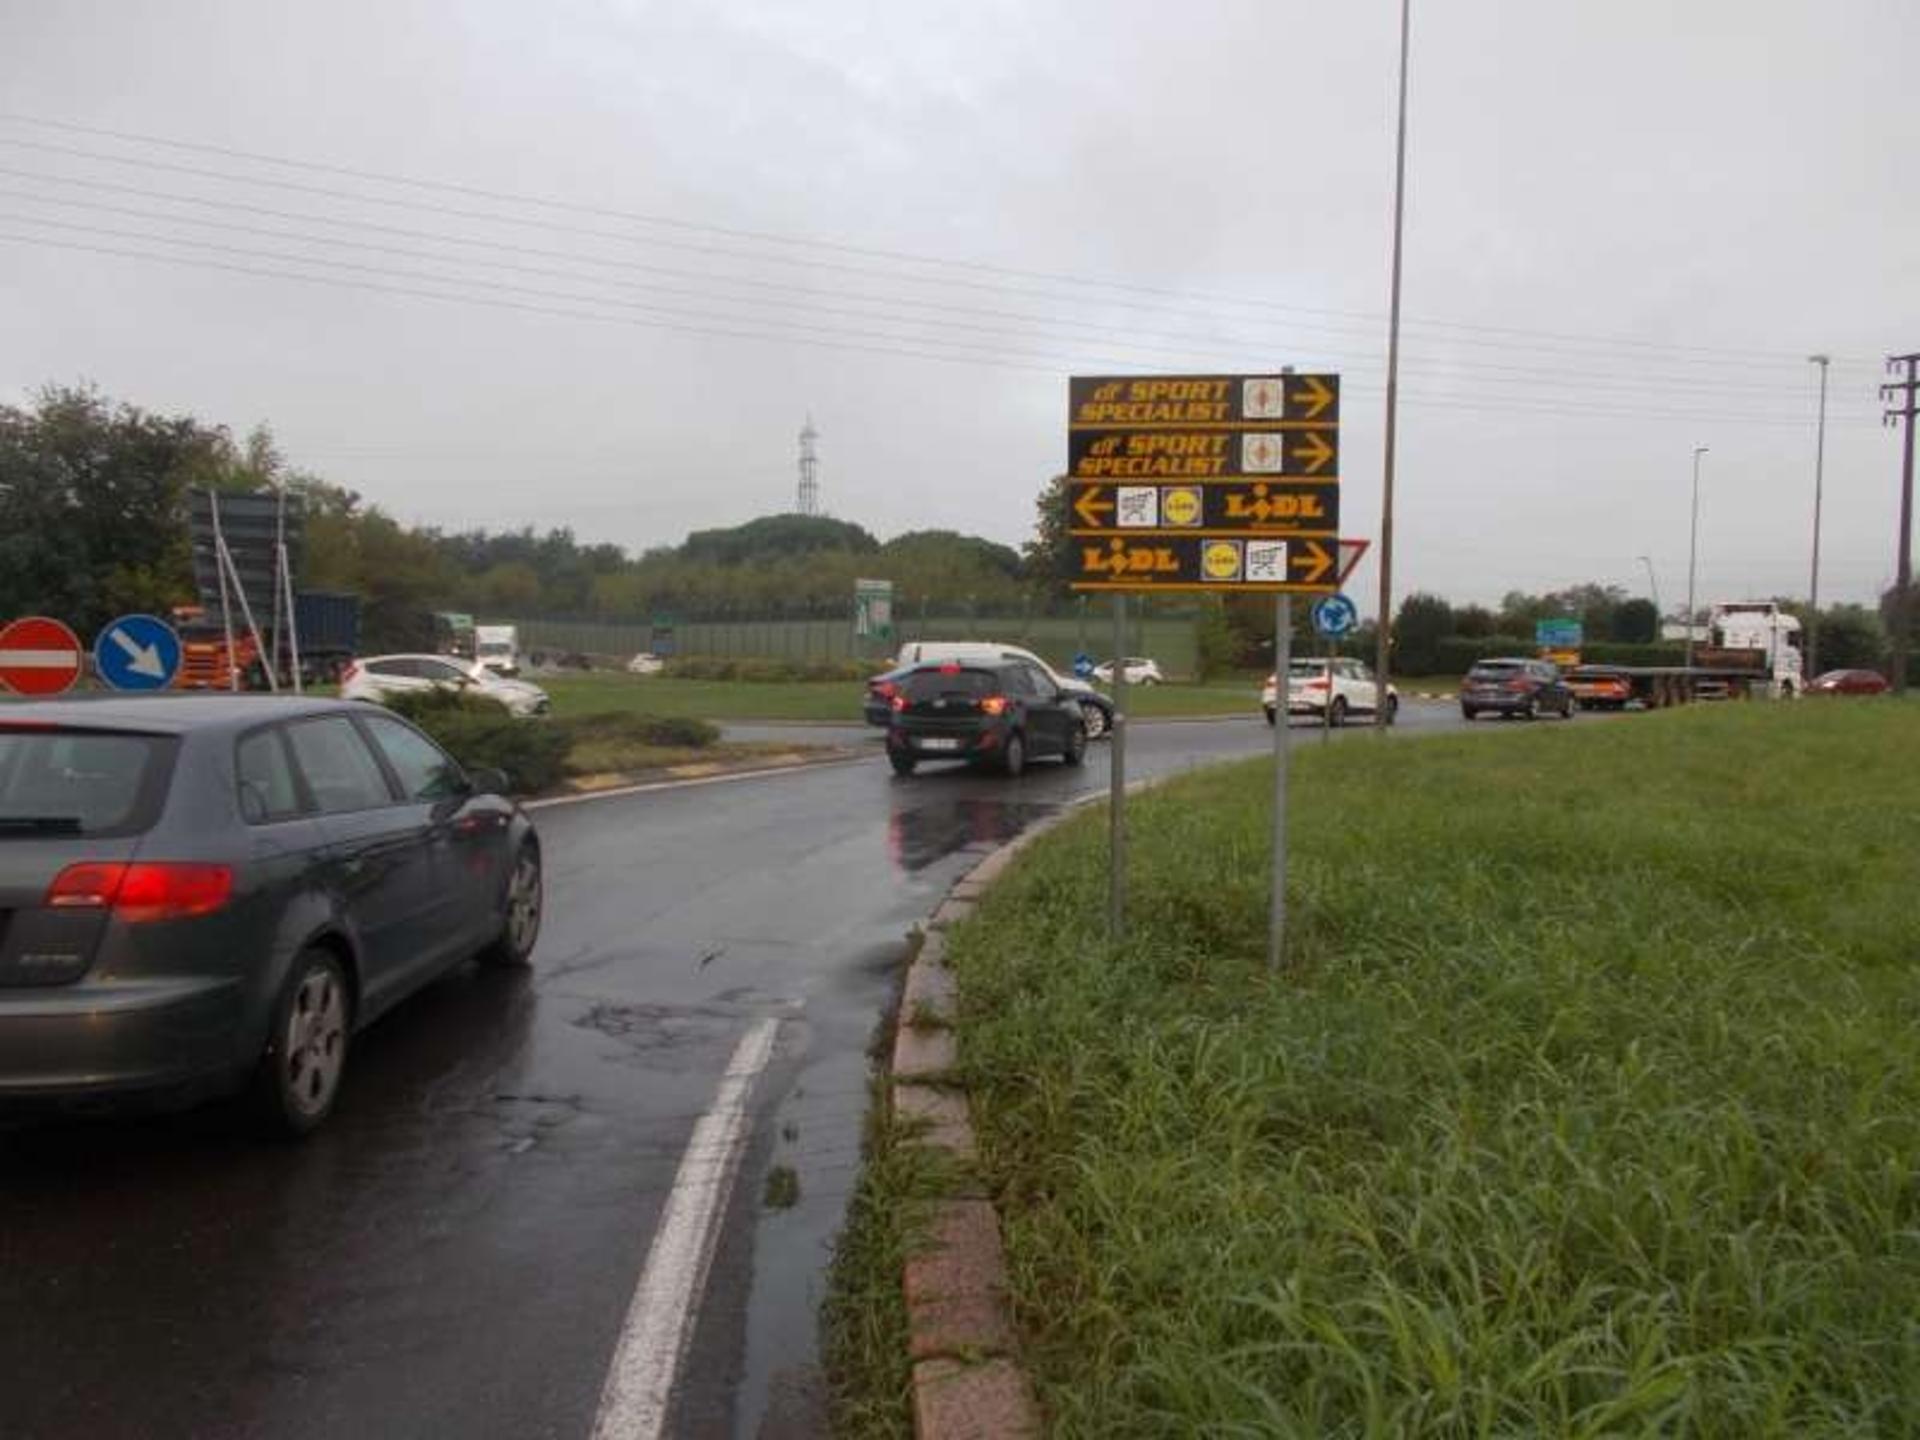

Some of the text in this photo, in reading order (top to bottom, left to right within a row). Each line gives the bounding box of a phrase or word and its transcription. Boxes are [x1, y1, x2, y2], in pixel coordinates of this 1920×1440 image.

[1131, 380, 1230, 400] SPORT
[1078, 402, 1230, 421] SPECIALIST
[1127, 434, 1230, 455] SPORT
[1076, 457, 1226, 475] SPECIALIST
